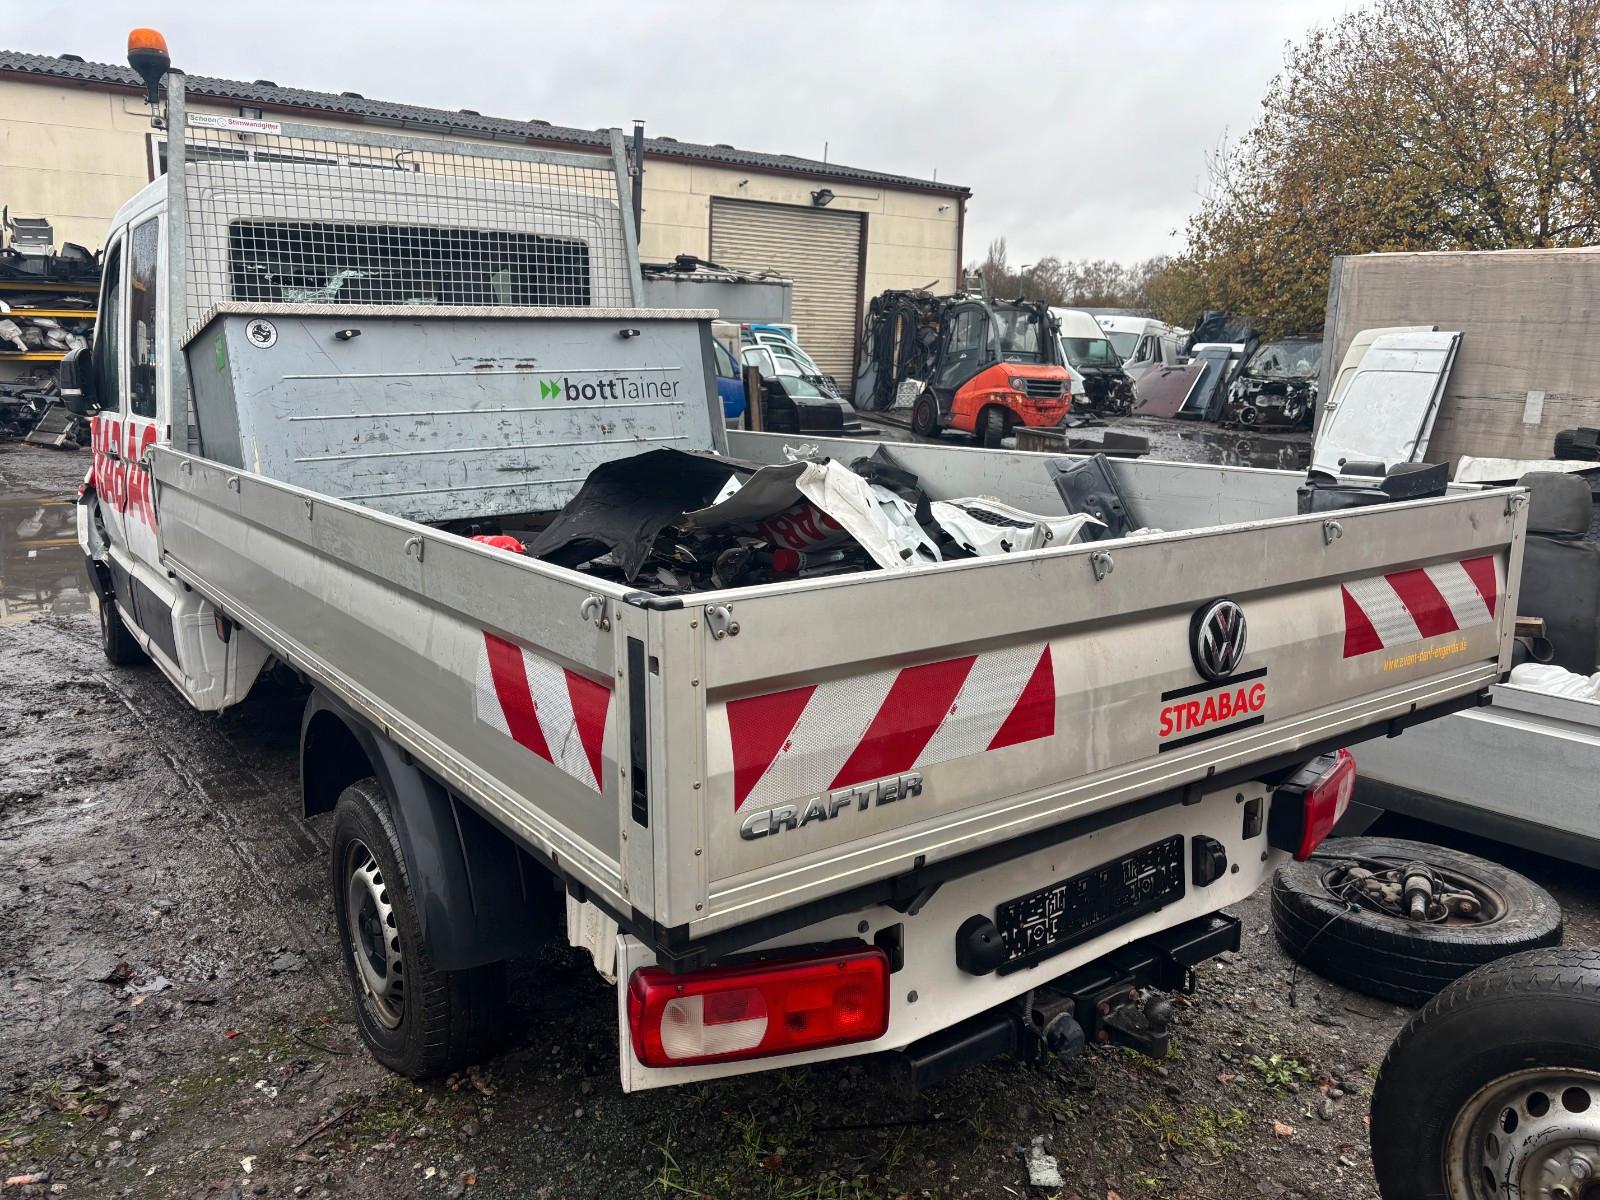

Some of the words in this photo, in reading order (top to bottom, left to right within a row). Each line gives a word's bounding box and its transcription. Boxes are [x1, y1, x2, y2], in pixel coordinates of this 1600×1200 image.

[564, 377, 680, 401] bottTainer
[1159, 682, 1266, 737] STRABAG
[740, 772, 924, 841] CRAFTER
